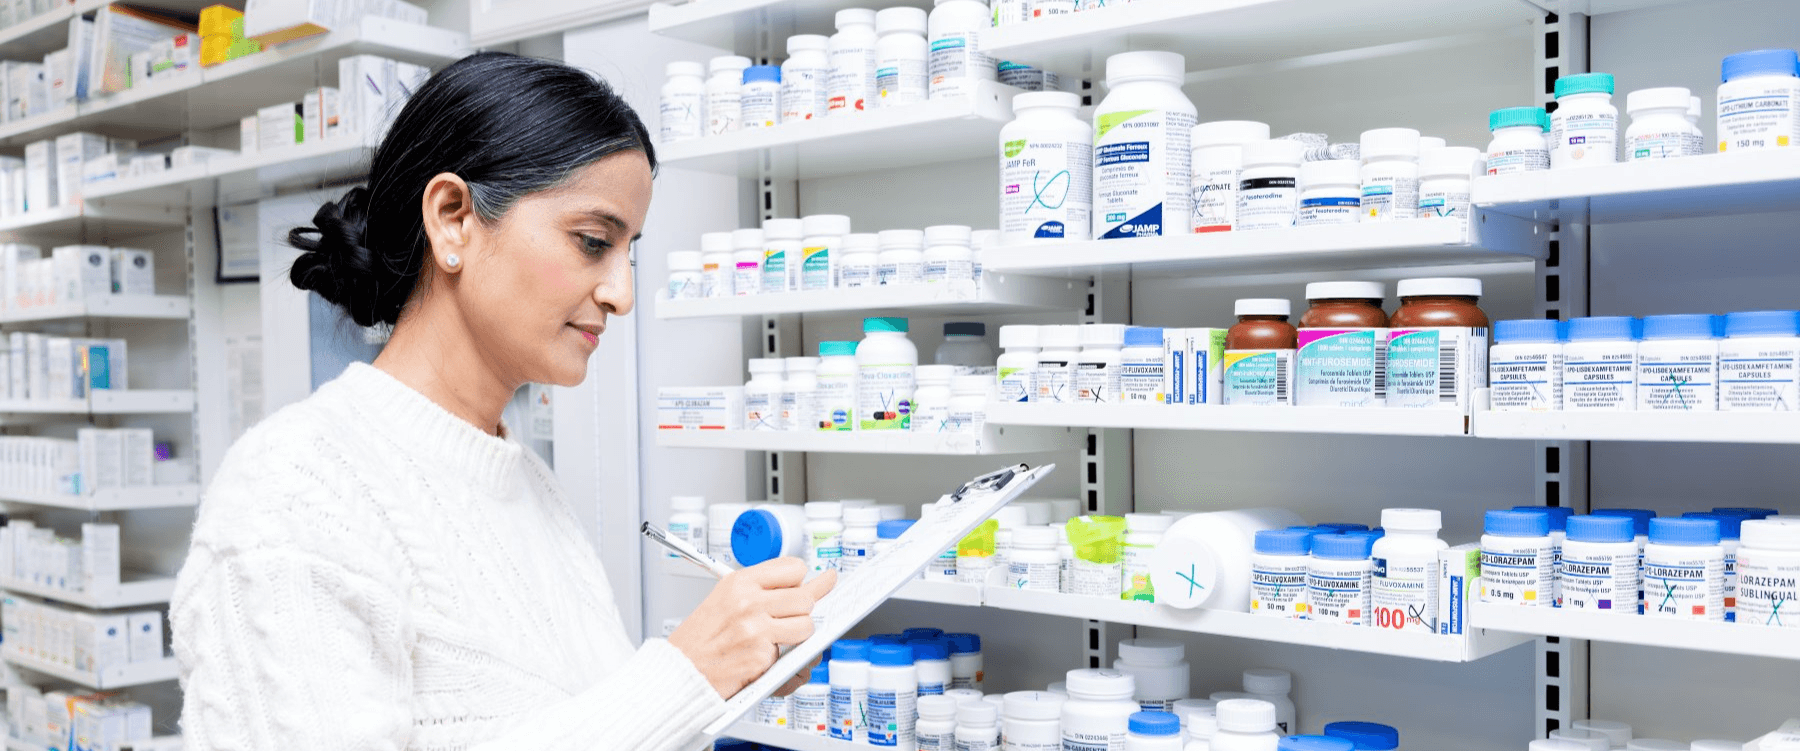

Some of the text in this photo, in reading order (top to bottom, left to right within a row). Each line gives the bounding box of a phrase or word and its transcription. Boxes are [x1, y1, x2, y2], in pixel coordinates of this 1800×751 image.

[1754, 100, 1788, 108] CARBONATE
[1006, 158, 1036, 170] JAMP FeR
[1133, 224, 1160, 233] JAMP
[1562, 564, 1610, 574] O-LORAZEPAM
[1254, 573, 1305, 584] APO-FLUVOXAMINE
[1740, 574, 1796, 588] LORAZEPAM
[1379, 580, 1424, 589] FLUVOXAMINE
[1490, 589, 1514, 600] 0.5 mg
[1740, 588, 1798, 601] SUBLINGUAL
[1573, 599, 1584, 608] mg
[1664, 606, 1676, 614] mg
[1374, 606, 1420, 630] 100 mg
